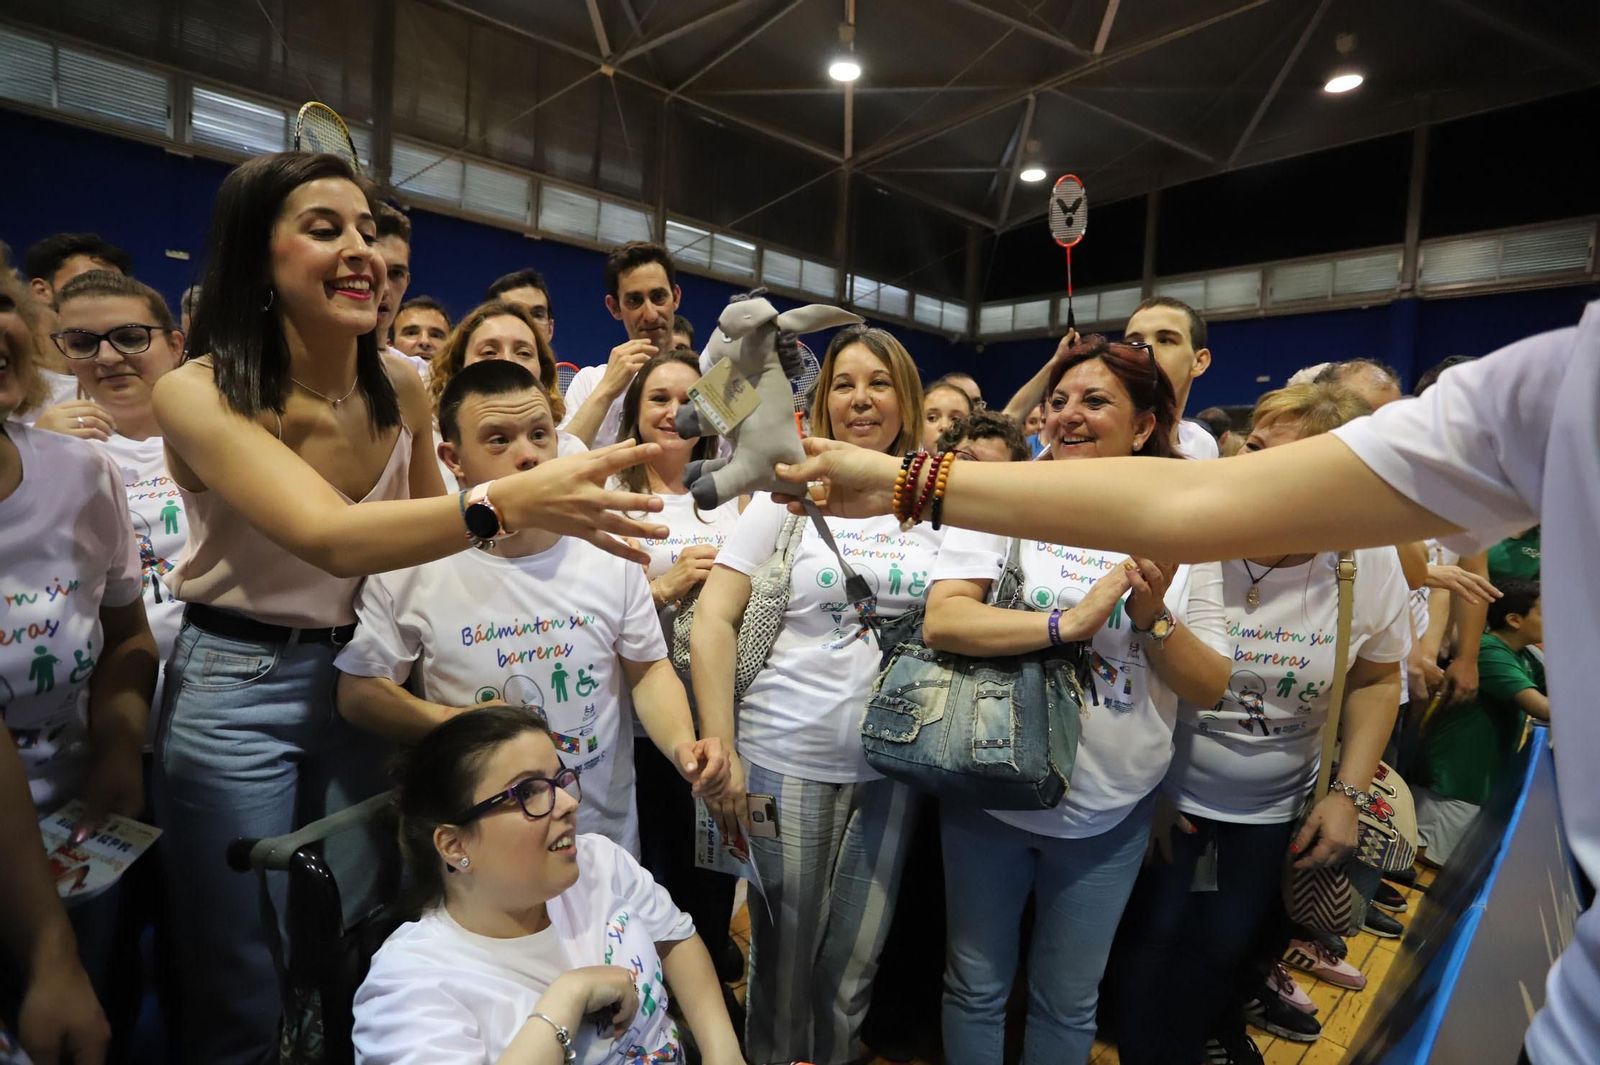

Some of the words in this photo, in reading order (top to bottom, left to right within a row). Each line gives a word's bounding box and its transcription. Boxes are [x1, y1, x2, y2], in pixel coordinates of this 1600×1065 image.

[127, 489, 183, 501] rrera
[842, 543, 906, 561] barreras
[1036, 540, 1118, 570] Bádminto
[1060, 564, 1097, 585] barr
[0, 619, 60, 646] eras
[461, 616, 566, 646] Bádminton
[569, 610, 595, 630] sin
[1309, 628, 1335, 646] sin
[497, 642, 574, 668] barreras
[1234, 644, 1311, 669] barreras
